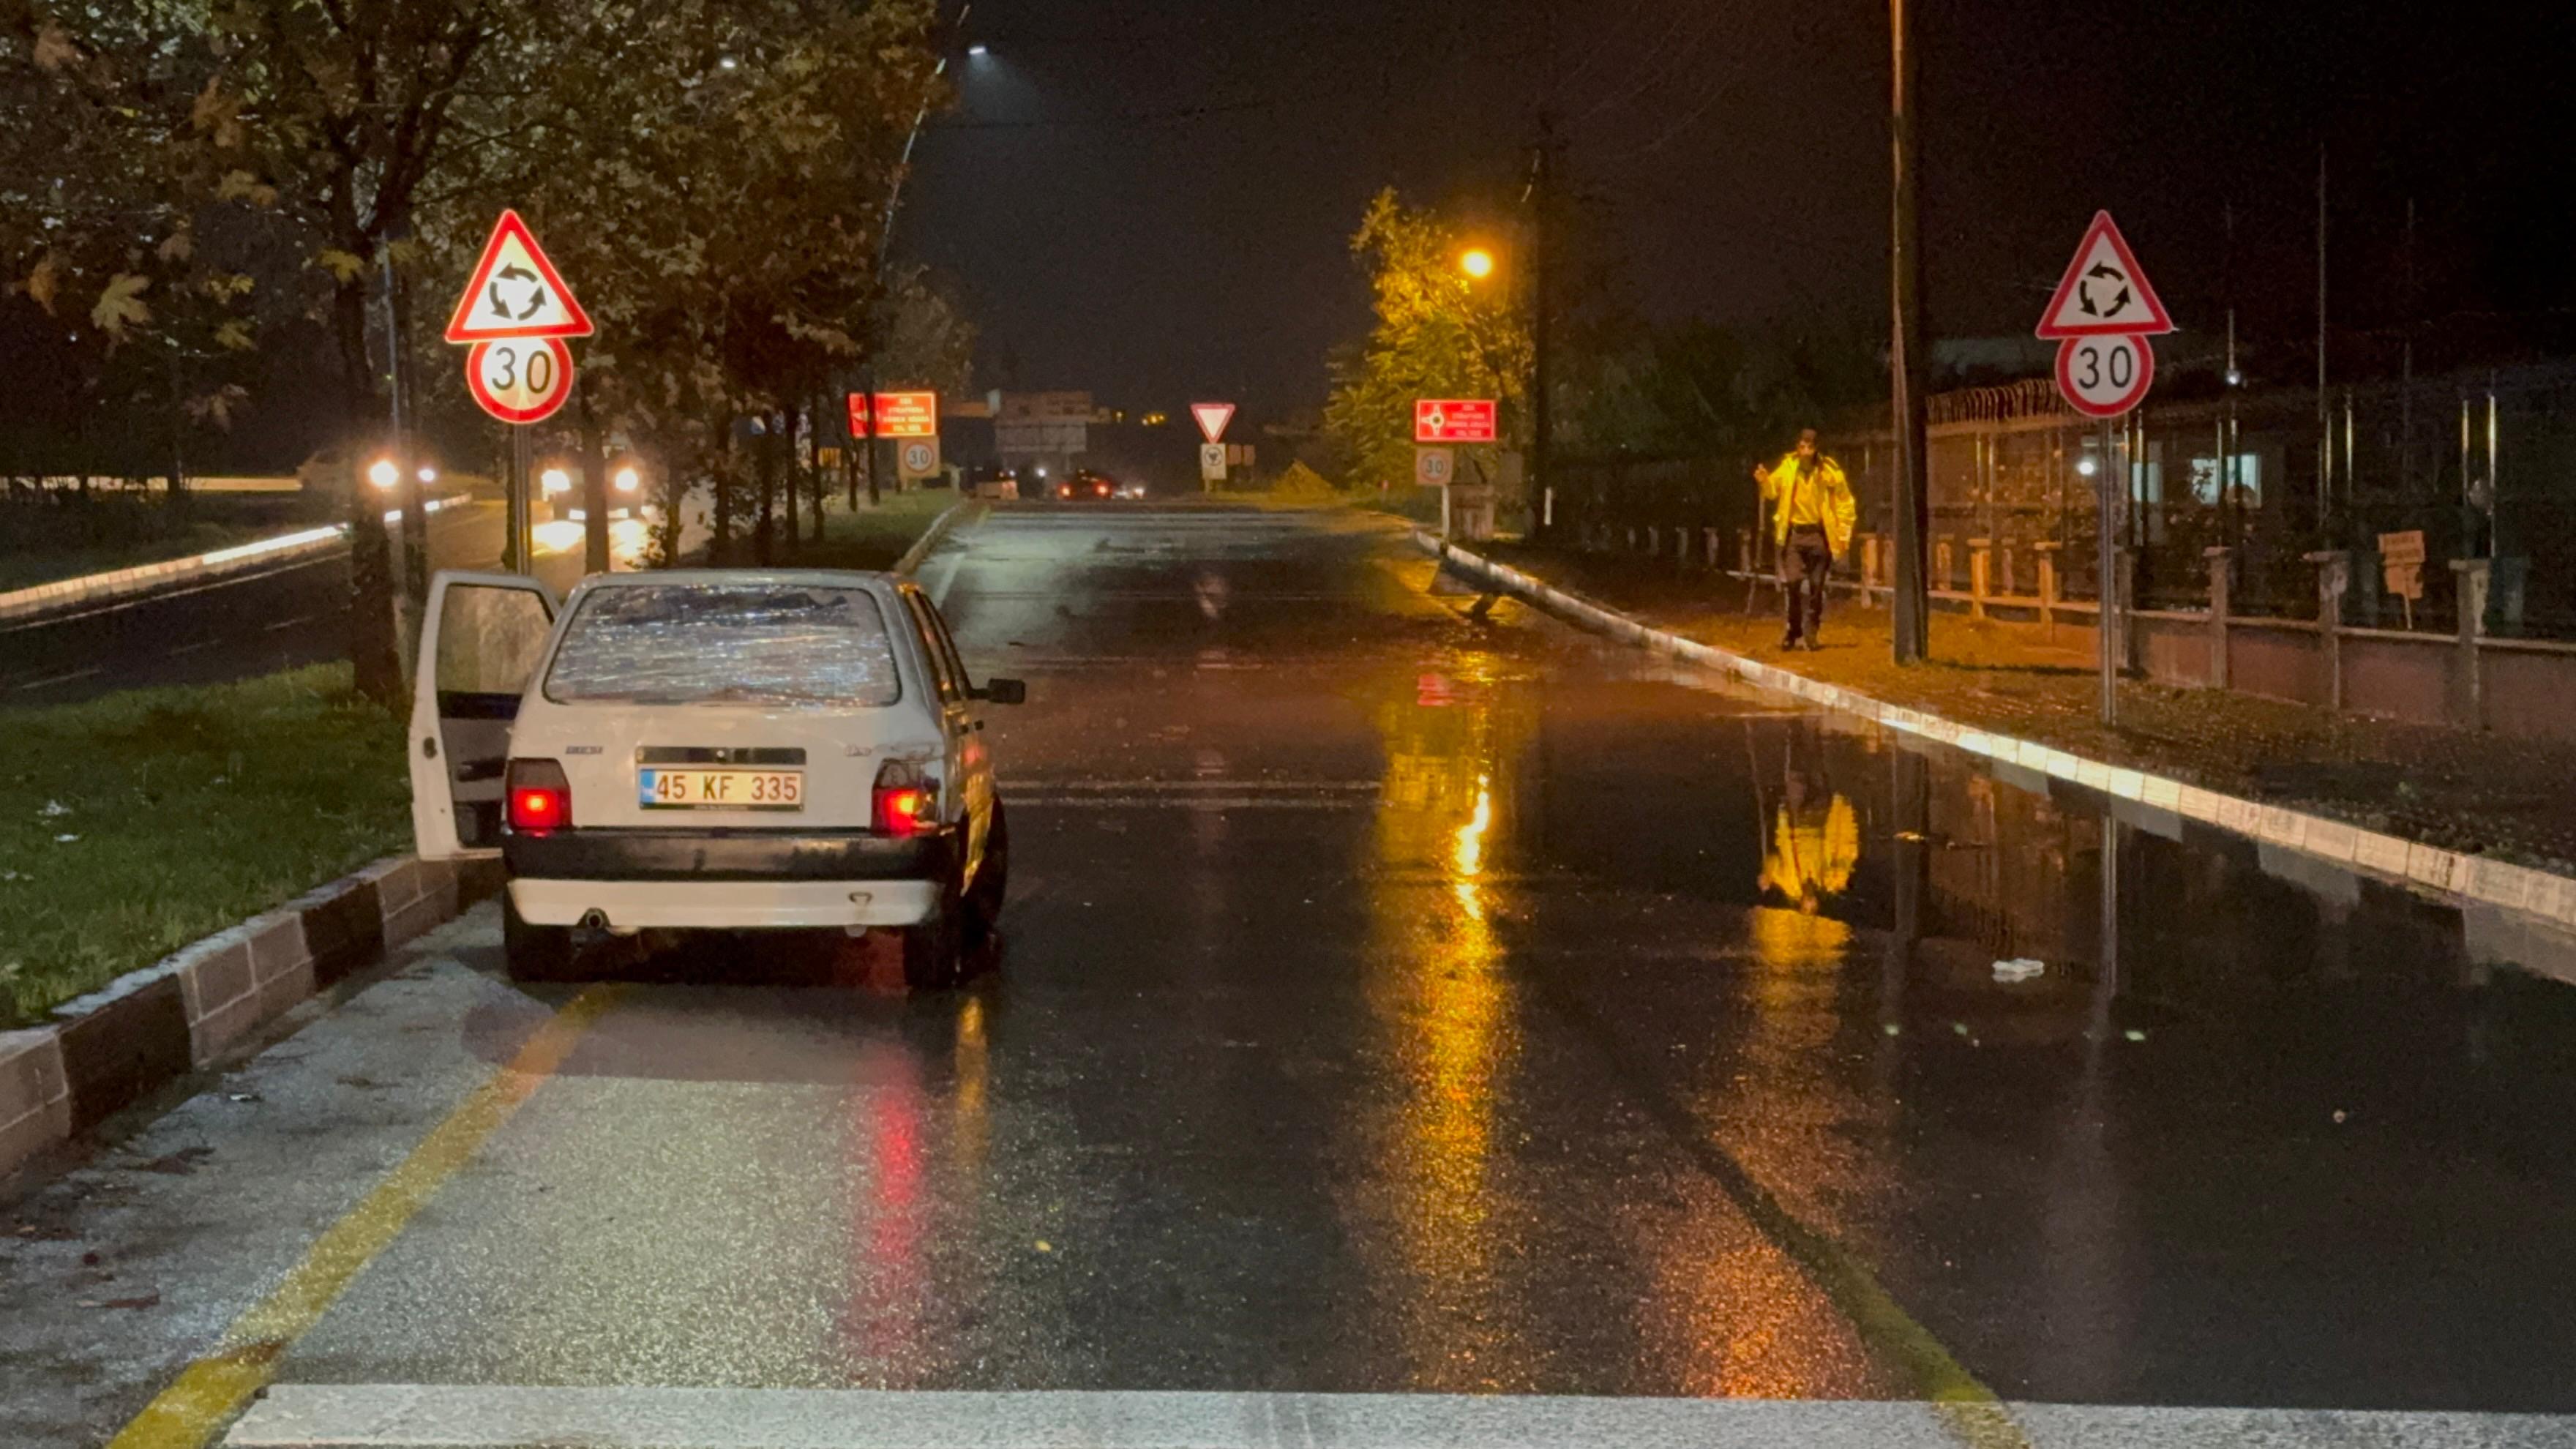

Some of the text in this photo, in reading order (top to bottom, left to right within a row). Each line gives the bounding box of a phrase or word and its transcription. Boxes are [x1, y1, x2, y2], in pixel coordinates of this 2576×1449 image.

[492, 347, 551, 394] 30
[2078, 345, 2132, 389] 30
[908, 449, 929, 465] 30
[656, 774, 798, 801] 45 KF 335
